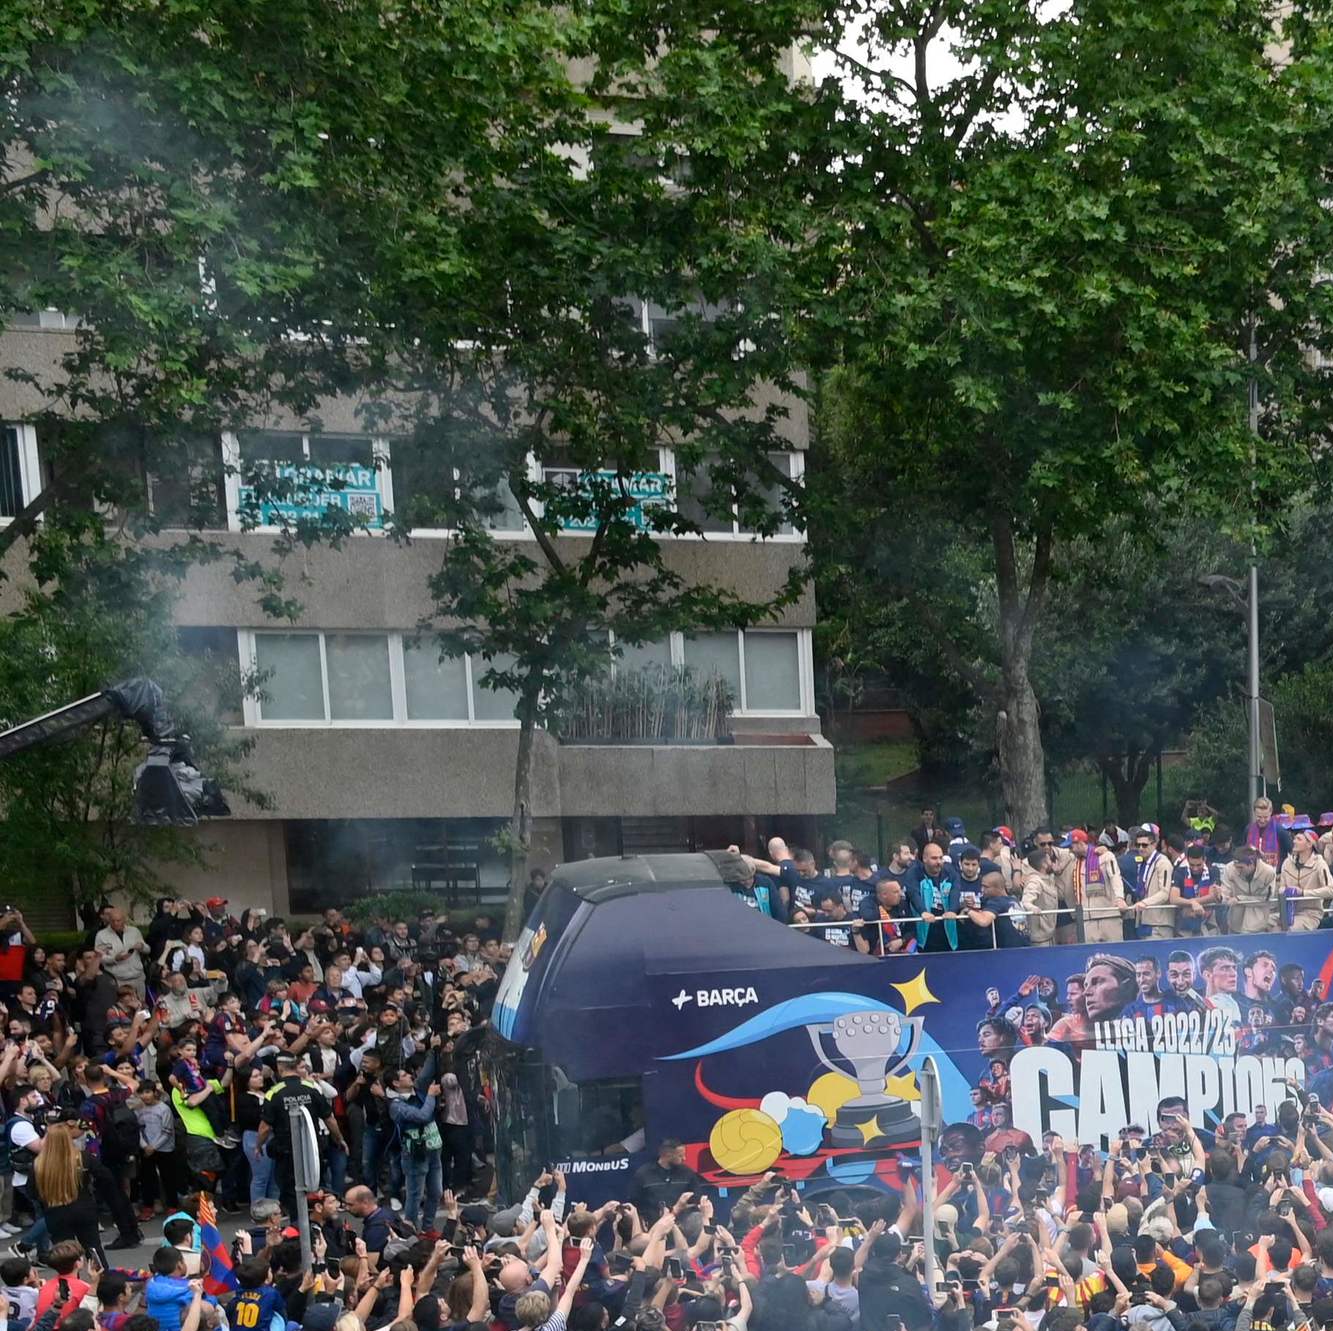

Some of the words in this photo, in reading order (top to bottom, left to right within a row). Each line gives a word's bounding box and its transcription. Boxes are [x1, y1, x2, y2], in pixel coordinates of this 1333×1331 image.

[697, 987, 758, 1008] BARÇA
[1094, 1016, 1149, 1052] LLIGA
[1151, 1009, 1237, 1056] 2022/23
[1009, 1046, 1307, 1155] CAMPIONS
[236, 1301, 261, 1329] 10
